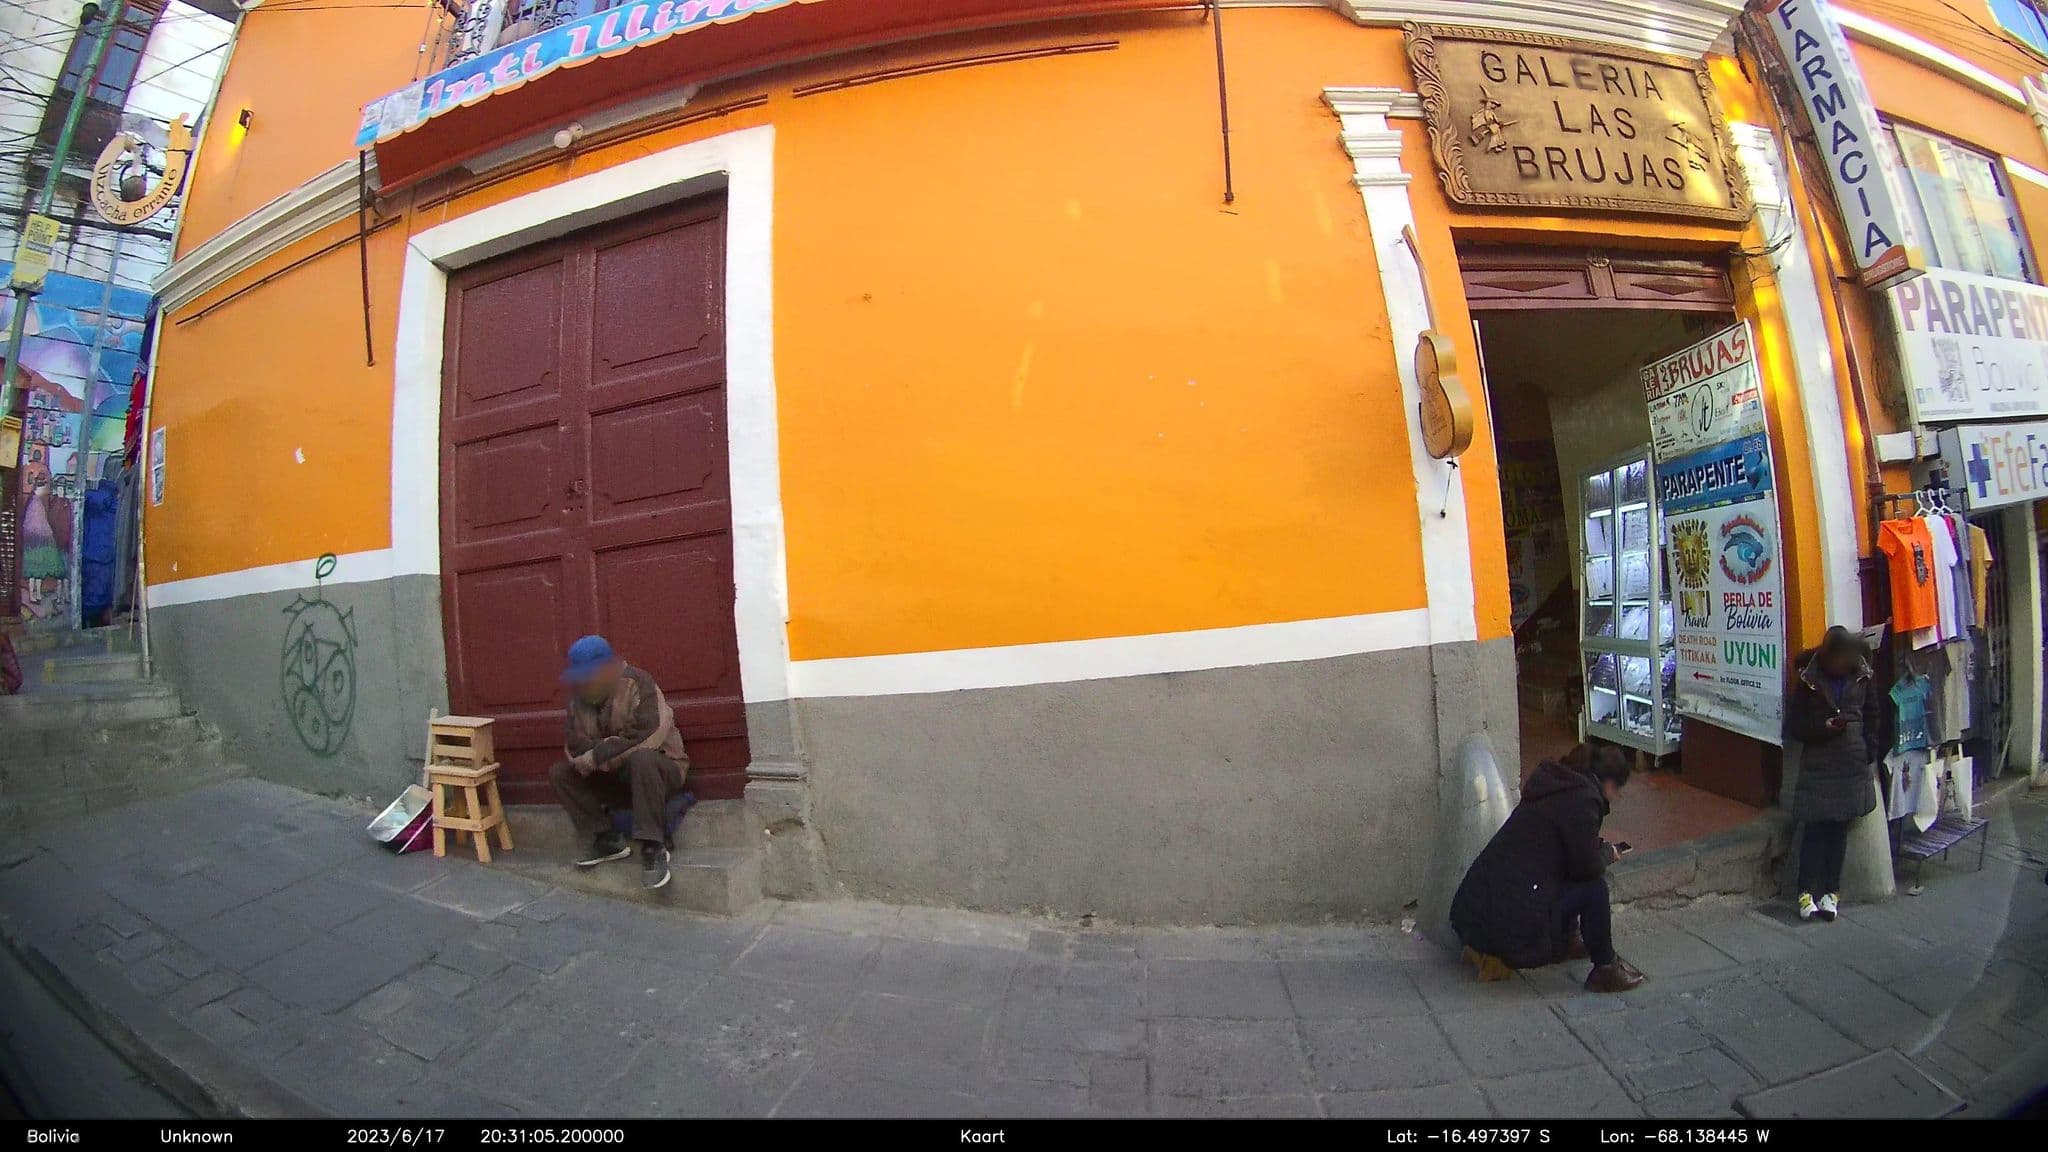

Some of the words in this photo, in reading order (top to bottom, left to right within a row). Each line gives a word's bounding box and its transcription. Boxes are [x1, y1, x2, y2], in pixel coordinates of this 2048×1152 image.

[427, 43, 543, 111] Inti
[567, 0, 765, 57] Illim
[1481, 51, 1663, 101] GALERIA
[1553, 100, 1637, 141] LAS
[1778, 0, 1892, 258] FARMACIA
[1513, 146, 1686, 191] BRUJAS
[28, 230, 53, 245] POINT
[1667, 328, 1746, 389] BRUJAS
[1663, 454, 1748, 501] PARAPENTE
[1723, 591, 1756, 608] PERLA
[1758, 591, 1773, 607] DE
[1724, 603, 1773, 631] Bolivia
[1680, 649, 1717, 664] TITIKAKA
[1723, 640, 1777, 670] UYUNI
